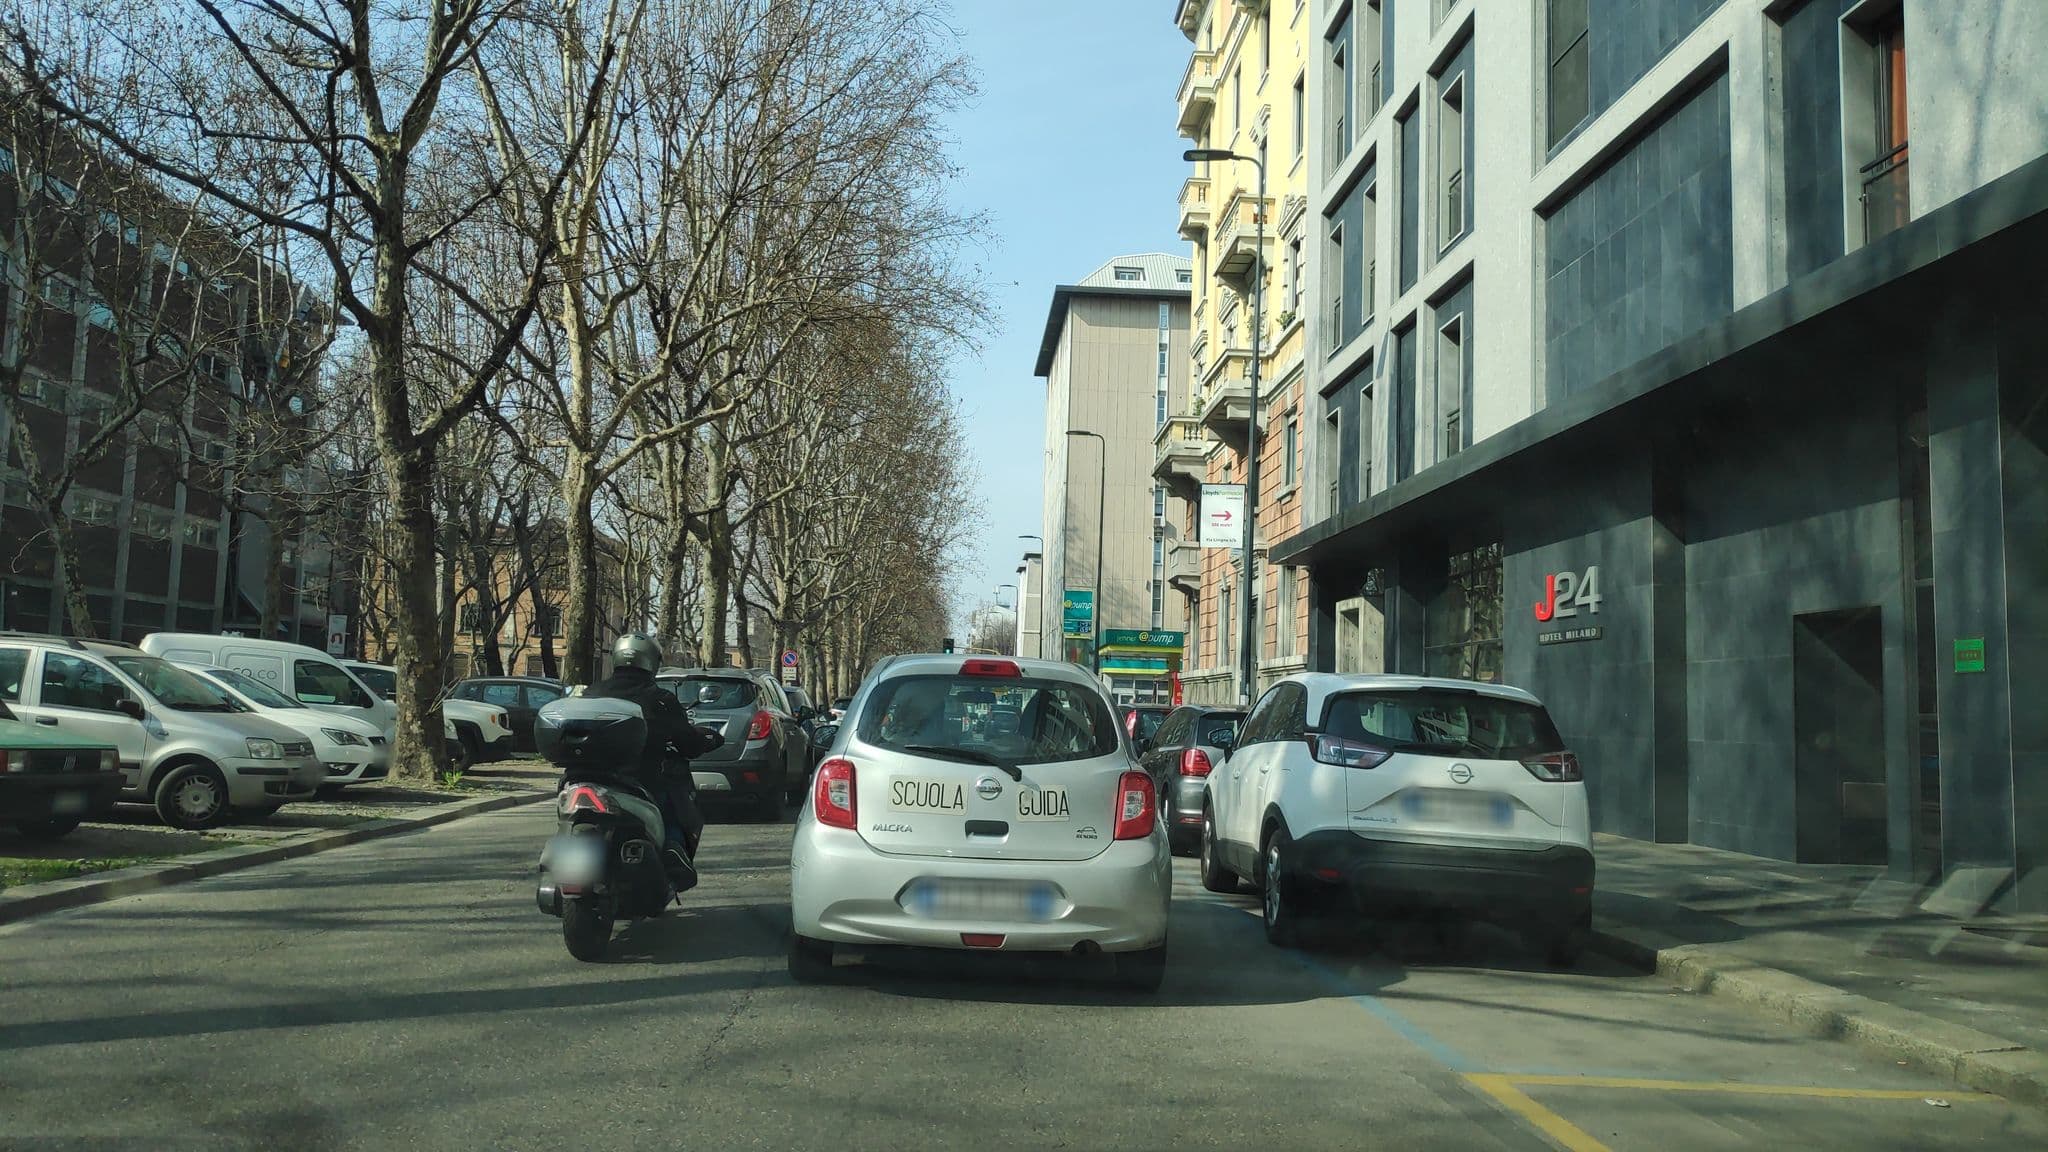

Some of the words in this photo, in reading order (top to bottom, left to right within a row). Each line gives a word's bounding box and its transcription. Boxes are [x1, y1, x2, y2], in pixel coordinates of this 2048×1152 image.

[1535, 565, 1602, 621] J24
[1539, 632, 1563, 642] HOTEL
[1565, 628, 1597, 640] MILANO
[892, 780, 964, 810] SCUOLA
[1018, 789, 1069, 816] GUIDA
[872, 823, 912, 832] MICRA
